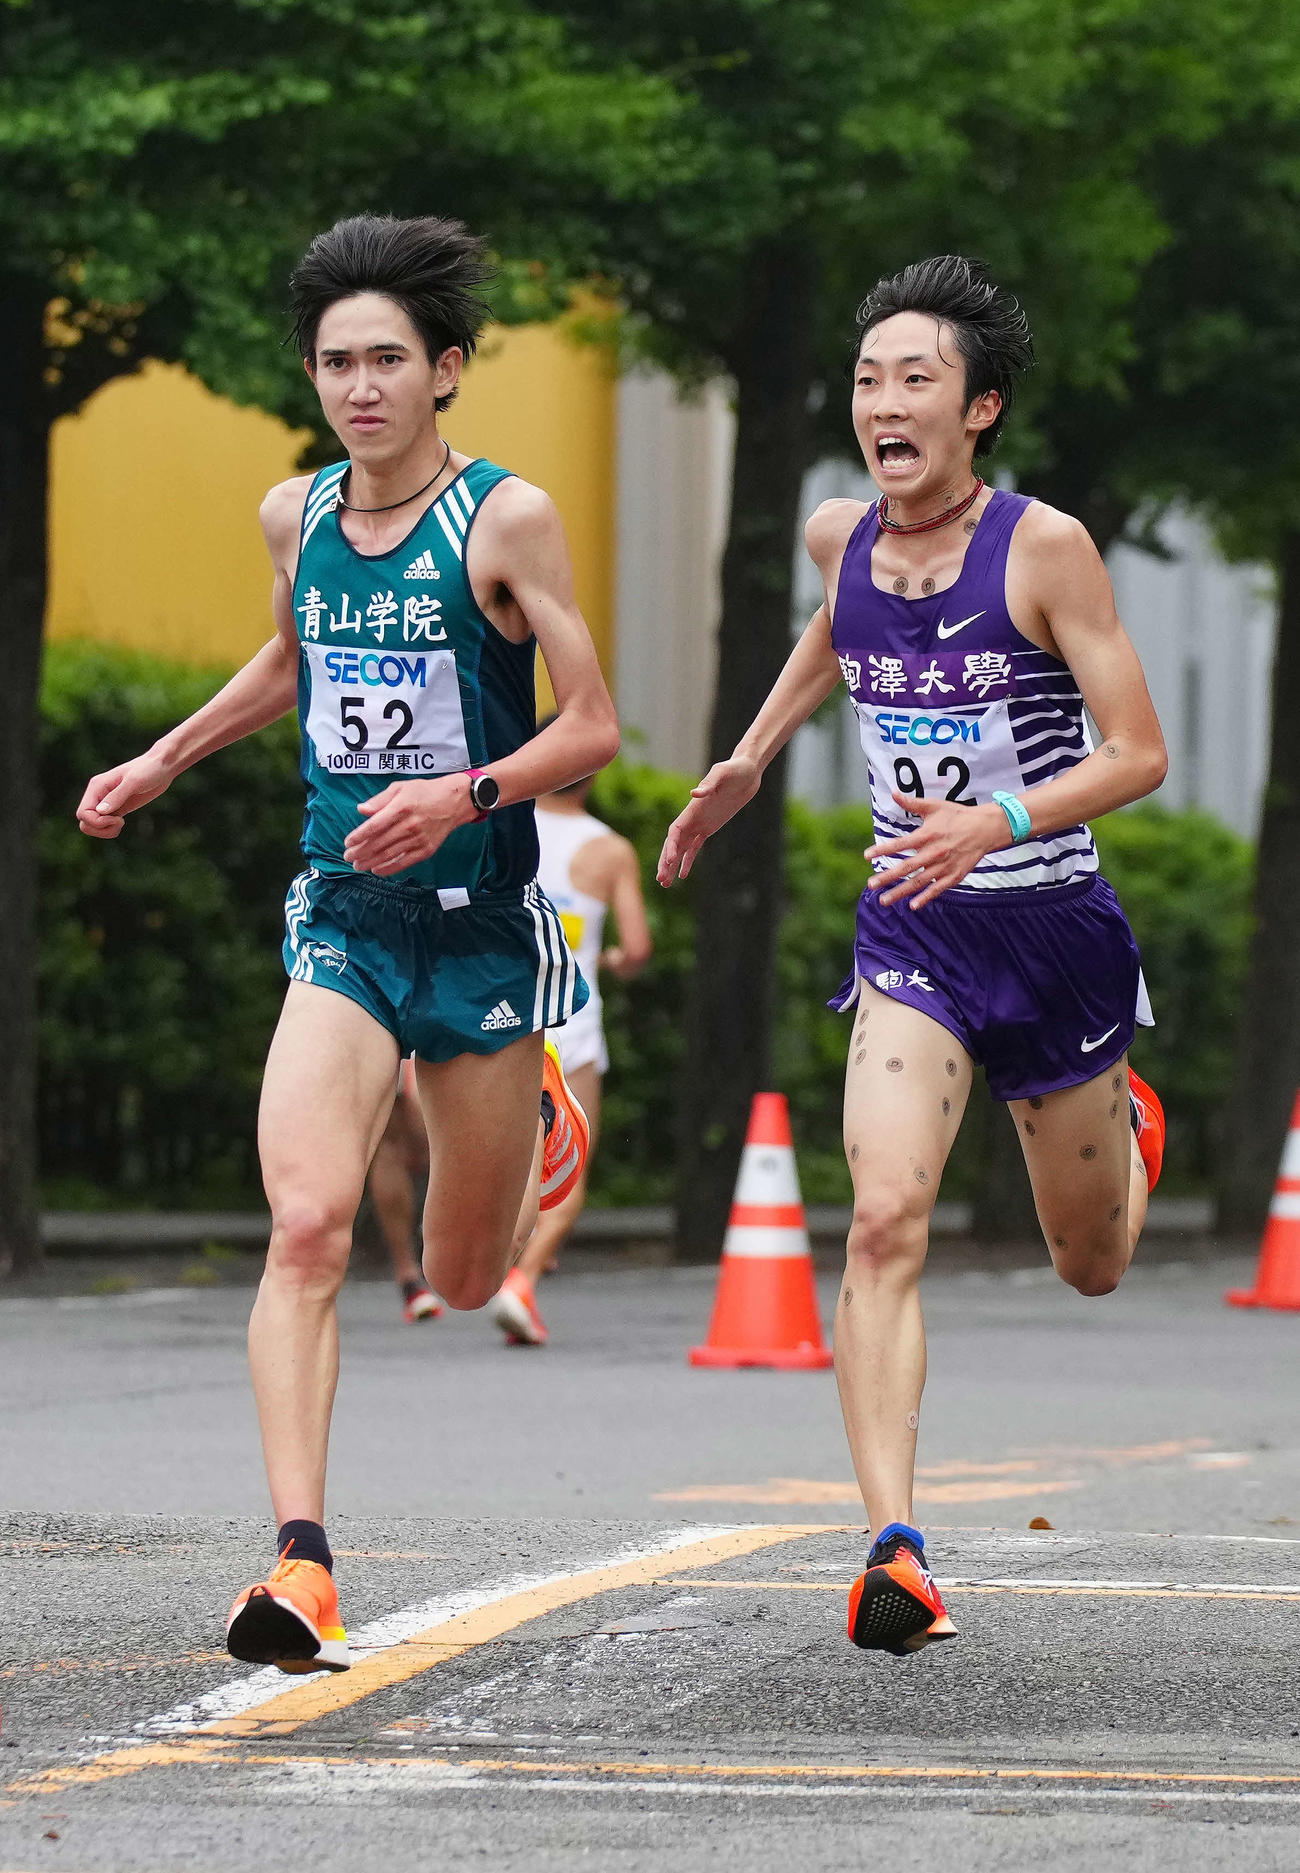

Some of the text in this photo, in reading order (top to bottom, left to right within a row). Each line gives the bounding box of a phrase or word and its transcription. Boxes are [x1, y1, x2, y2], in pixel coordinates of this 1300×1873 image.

[403, 568, 441, 580] adidas
[297, 586, 448, 643] 青山学院
[325, 652, 427, 688] SECOM
[340, 696, 420, 752] 52
[875, 713, 981, 746] SECOM
[326, 753, 435, 770] 100回 関東IC
[893, 756, 978, 807] 92
[875, 969, 935, 993] 駒大
[480, 1016, 522, 1031] adidas
